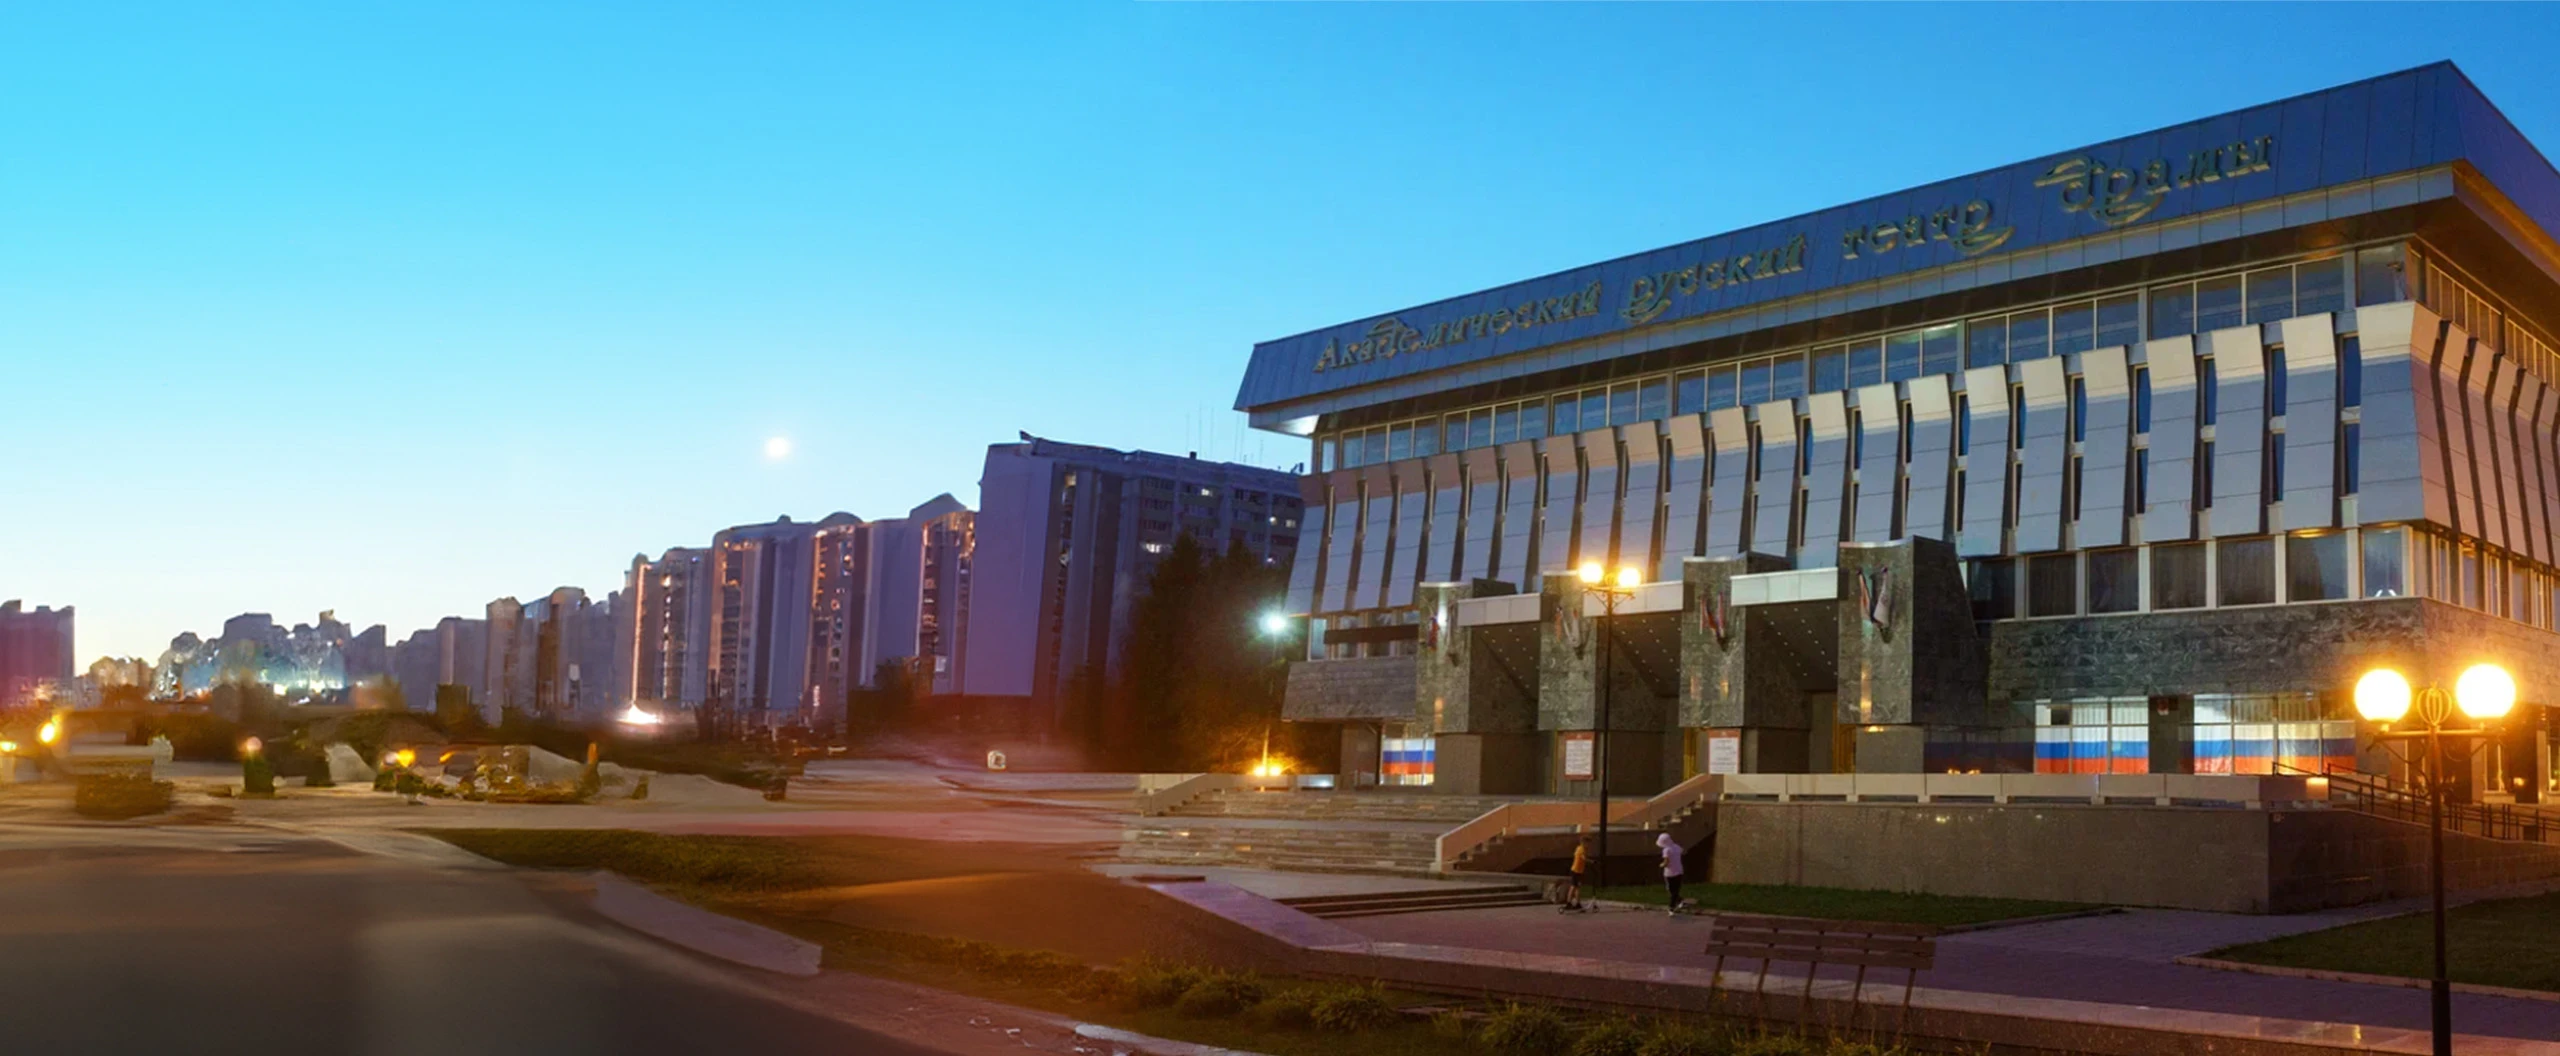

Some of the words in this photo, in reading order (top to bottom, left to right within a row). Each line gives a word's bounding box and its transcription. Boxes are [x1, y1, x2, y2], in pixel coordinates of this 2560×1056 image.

[1313, 279, 1602, 373] Академический
[1618, 232, 1807, 325] русский
[1842, 199, 2016, 260] театр
[2034, 134, 2272, 226] драмы
